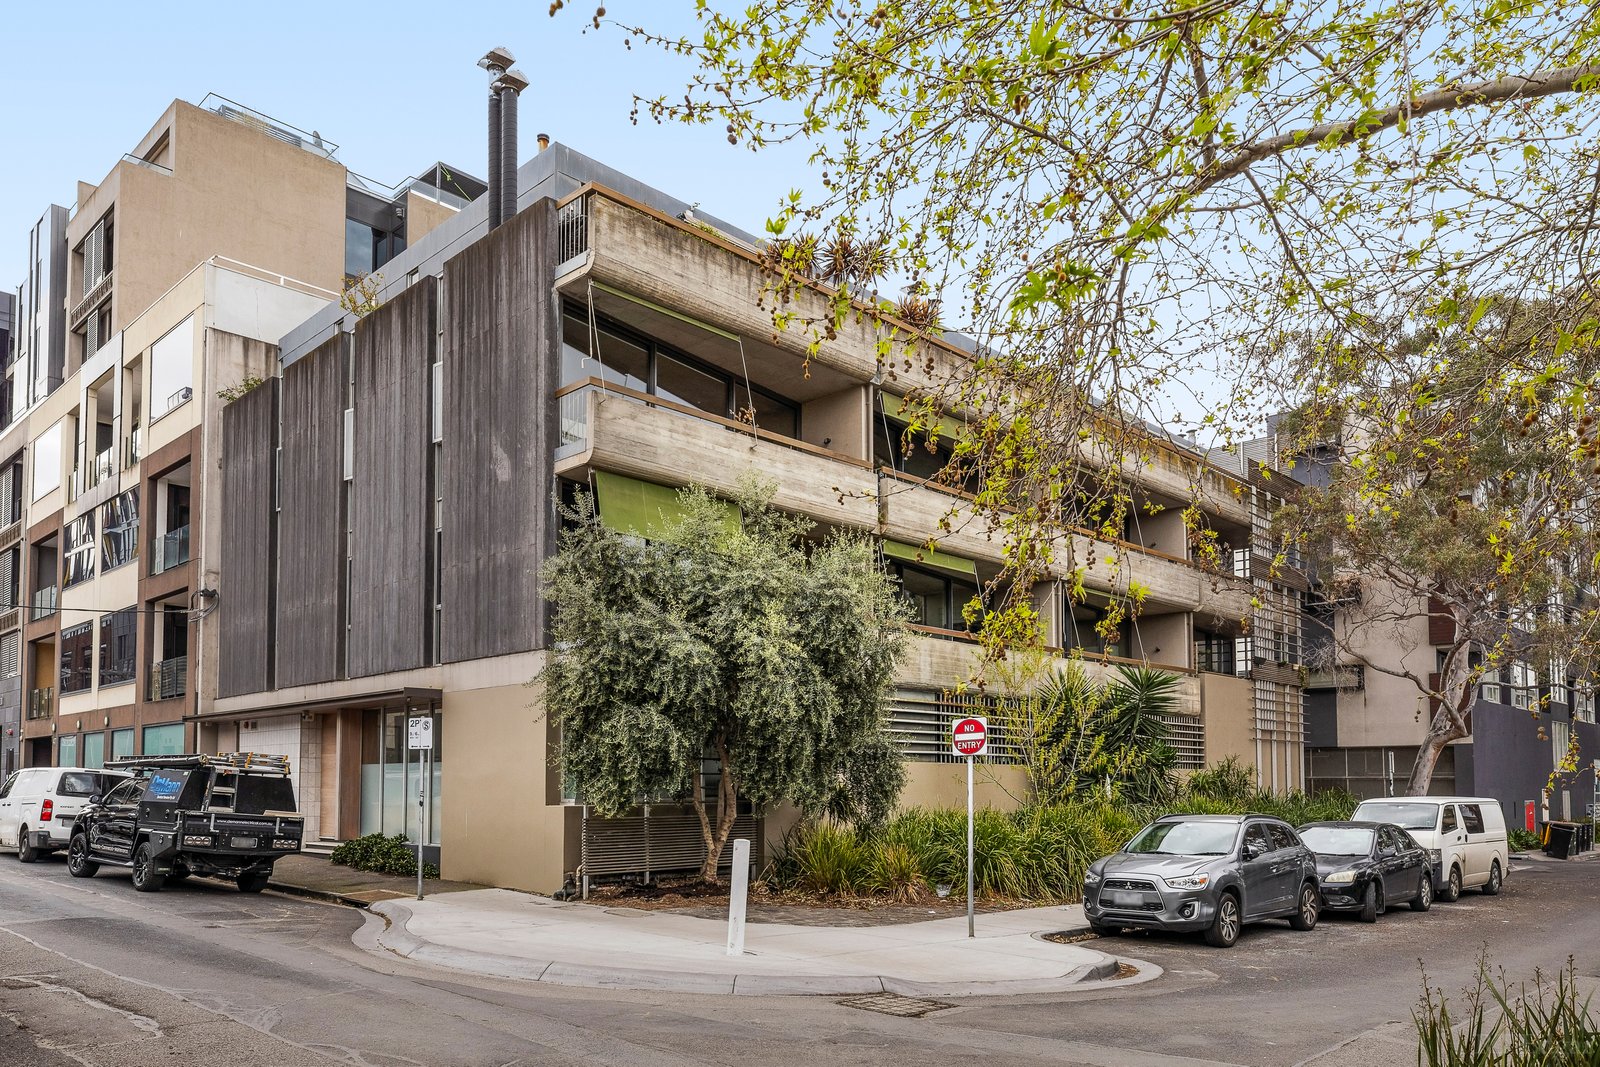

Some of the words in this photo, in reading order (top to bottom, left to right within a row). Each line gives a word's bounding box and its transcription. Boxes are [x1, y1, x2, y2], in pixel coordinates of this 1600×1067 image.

[410, 719, 420, 727] 2P
[964, 724, 975, 732] NO
[957, 741, 982, 749] ENTRY
